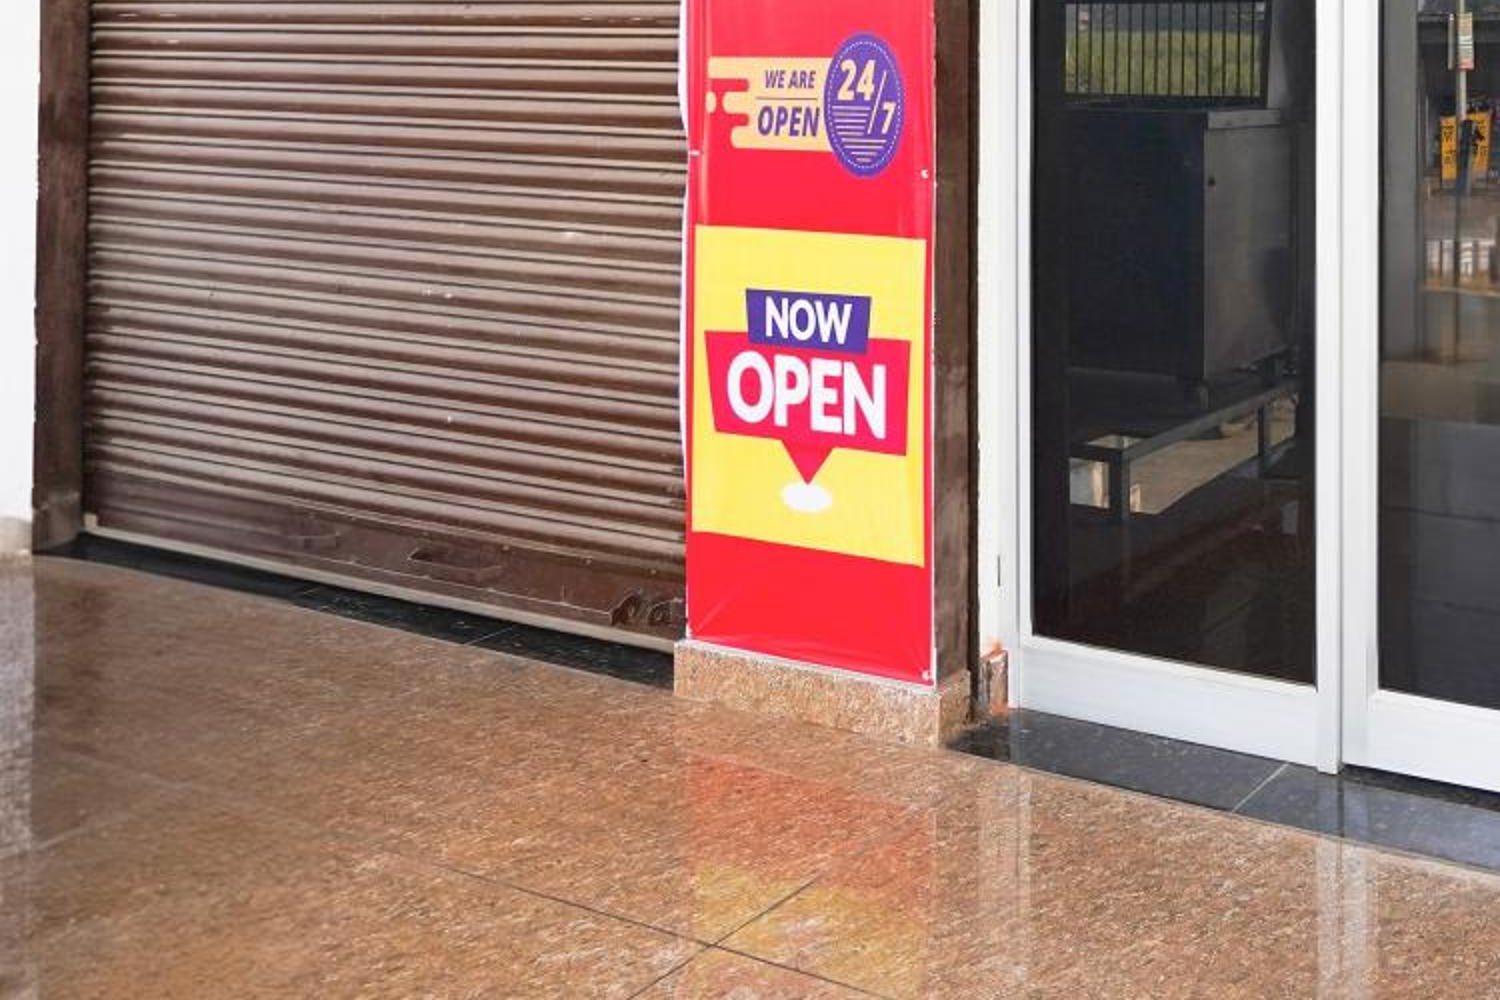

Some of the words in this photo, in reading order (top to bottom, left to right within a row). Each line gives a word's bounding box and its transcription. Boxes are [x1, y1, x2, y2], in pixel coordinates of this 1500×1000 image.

[764, 69, 786, 89] WE
[788, 69, 817, 89] ARE
[757, 105, 820, 137] OPEN
[764, 296, 853, 346] NOW
[726, 349, 887, 441] OPEN
